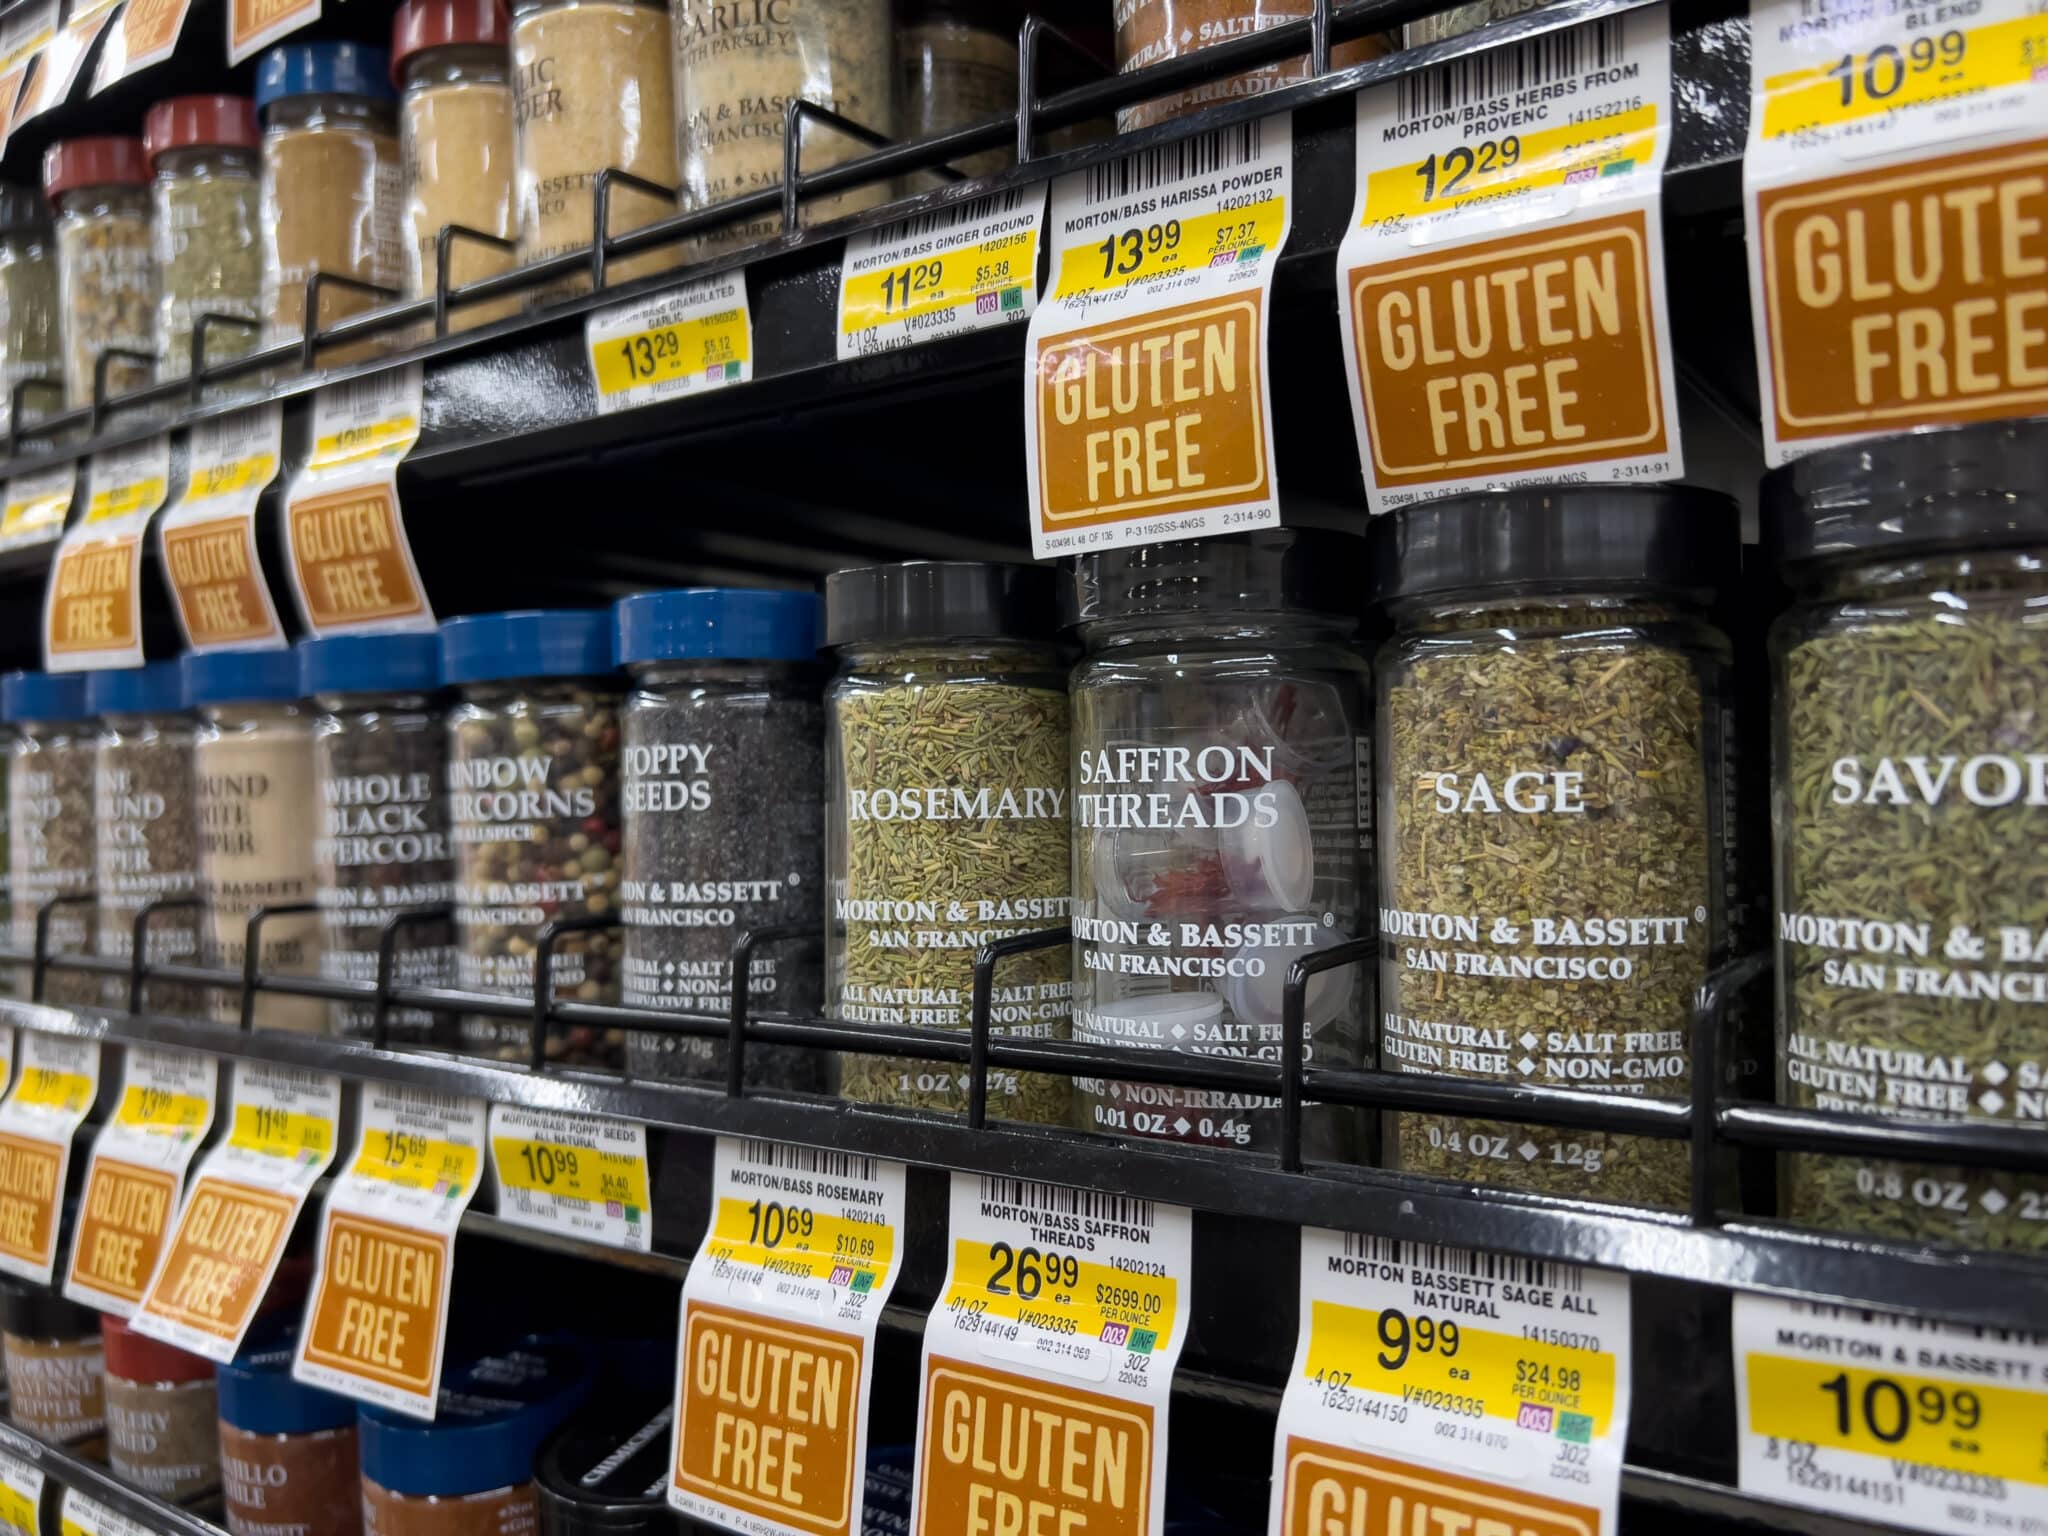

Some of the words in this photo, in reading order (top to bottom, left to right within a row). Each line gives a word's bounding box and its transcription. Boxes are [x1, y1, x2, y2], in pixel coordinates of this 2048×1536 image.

[1199, 16, 1254, 41] SALT
[1905, 0, 1982, 30] BLEND
[1383, 103, 1509, 142] MORTON/BASS
[1515, 80, 1578, 108] HERBS
[1584, 63, 1640, 90] FROM
[1567, 96, 1642, 127] 14152216
[1463, 105, 1549, 139] PROVENC
[1065, 198, 1156, 233] MORTON/BASS
[1161, 183, 1217, 209] HARISSA
[1222, 166, 1283, 193] POWDER
[1217, 188, 1273, 214] 14202132
[853, 242, 932, 272] MORTON/BASS
[936, 229, 979, 249] GINGER
[983, 214, 1034, 237] GROUND
[979, 232, 1027, 254] 14202156
[1216, 221, 1256, 245] $7.37
[1794, 176, 2048, 309] GLUTE
[976, 261, 1009, 282] $5.38
[669, 285, 735, 312] GRANULATED
[1377, 250, 1620, 372] GLUTEN
[648, 312, 683, 330] GARLIC
[864, 326, 878, 345] OZ
[904, 307, 956, 332] V#023335
[1852, 291, 2048, 405] FREE
[1054, 320, 1236, 425] GLUTEN
[1426, 357, 1587, 457] FREE
[1086, 413, 1206, 503] FREE
[1613, 461, 1671, 479] 2-314-91
[301, 500, 391, 563] GLUTEN
[1223, 508, 1272, 524] 2-314-90
[60, 548, 128, 594] GLUTEN
[171, 532, 248, 583] GLUTEN
[322, 560, 391, 611] FREE
[66, 598, 114, 641] FREE
[194, 585, 249, 634] FREE
[1080, 745, 1276, 784] SAFFRON
[321, 773, 432, 806] WHOLE
[624, 779, 713, 812] SEEDS
[849, 787, 1066, 821] ROSEMARY
[1434, 771, 1585, 813] SAGE
[325, 803, 428, 836] BLACK
[1079, 792, 1279, 829] THREADS
[488, 880, 585, 903] BASSETT
[635, 907, 735, 926] FRANCISCO
[836, 899, 936, 922] MORTON
[946, 901, 969, 922] &
[1379, 907, 1479, 943] MORTON
[1490, 917, 1520, 945] &
[870, 930, 912, 948] SAN
[1147, 922, 1171, 947] &
[1779, 911, 1931, 956] MORTON
[1943, 925, 1985, 960] &
[679, 960, 724, 976] SALT
[1084, 950, 1114, 972] SAN
[1119, 954, 1266, 977] FRANCISCO
[1405, 948, 1447, 972] SAN
[1455, 953, 1632, 980] FRANCISCO
[1823, 959, 1886, 991] SAN
[842, 985, 867, 1003] ALL
[870, 987, 962, 1005] NATURAL
[990, 985, 1035, 1003] SALT
[1039, 981, 1073, 1000] FREE
[842, 1003, 903, 1024] GLUTEN
[910, 1008, 960, 1025] FREE
[990, 1001, 1073, 1023] NON-GMO
[1085, 1011, 1164, 1040] NATURAL
[1193, 1024, 1253, 1042] SALT
[1384, 1013, 1405, 1035] ALL
[1408, 1020, 1511, 1050] NATURAL
[1546, 1032, 1617, 1053] SALT
[1624, 1031, 1682, 1053] FREE
[1384, 1036, 1442, 1066] GLUTEN
[1449, 1050, 1509, 1074] FREE
[1545, 1056, 1684, 1079] NON-GMO
[1788, 1033, 1820, 1061] ALL
[1825, 1041, 1974, 1084] NATURAL
[917, 1073, 951, 1092] OZ
[1079, 1076, 1105, 1097] MSG
[1788, 1059, 1878, 1099] GLUTEN
[1885, 1078, 1969, 1112] FREE
[535, 1132, 550, 1143] ALL
[554, 1134, 597, 1149] NATURAL
[569, 1121, 600, 1137] POPPY
[604, 1127, 636, 1142] SEEDS
[1095, 1105, 1127, 1130] 0.01
[1133, 1112, 1167, 1134] OZ
[1199, 1119, 1251, 1144] 0.4g
[1429, 1128, 1462, 1152] 0.4
[1468, 1135, 1509, 1160] OZ
[1550, 1144, 1601, 1173] 12g
[731, 1169, 813, 1196] MORTON/BASS
[817, 1182, 884, 1207] ROSEMARY
[1857, 1168, 1902, 1200] 0.8
[1912, 1178, 1968, 1212] OZ
[91, 1174, 169, 1237] GLUTEN
[841, 1207, 886, 1227] 14202143
[187, 1193, 282, 1265] GLUTEN
[981, 1202, 1080, 1233] MORTON/BASS
[1084, 1219, 1151, 1245] SAFFRON
[1030, 1226, 1096, 1252] THREADS
[90, 1230, 144, 1288] FREE
[836, 1234, 875, 1257] $10.69
[333, 1231, 436, 1310] GLUTEN
[763, 1256, 814, 1279] V#023335
[1109, 1255, 1166, 1278] 14202124
[171, 1253, 242, 1320] FREE
[1095, 1284, 1161, 1314] $2699.00
[1327, 1256, 1404, 1284] MORTON
[1411, 1270, 1494, 1299] BASSETT
[1502, 1285, 1554, 1308] SAGE
[1562, 1296, 1598, 1316] ALL
[967, 1301, 988, 1318] OZ
[1100, 1305, 1119, 1320] PER
[1120, 1310, 1151, 1326] OUNCE
[1413, 1289, 1501, 1320] NATURAL
[336, 1297, 410, 1369] FREE
[1016, 1308, 1079, 1336] V#023335
[1101, 1326, 1126, 1345] 003
[1522, 1324, 1600, 1354] 14150370
[1777, 1328, 1883, 1360] MORTON
[1918, 1349, 2031, 1380] BASSETT
[1118, 1370, 1149, 1388] 220425
[1124, 1353, 1151, 1373] 302
[1449, 1366, 1471, 1381] ea
[1516, 1359, 1581, 1391] $24.98
[697, 1329, 842, 1430] GLUTEN
[1327, 1371, 1352, 1394] OZ
[1321, 1391, 1408, 1424] 1629144150
[1403, 1383, 1484, 1418] V#023335
[1538, 1388, 1581, 1409] OUNCE
[712, 1411, 808, 1505] FREE
[942, 1389, 1128, 1509] GLUTEN
[1556, 1443, 1591, 1466] 302
